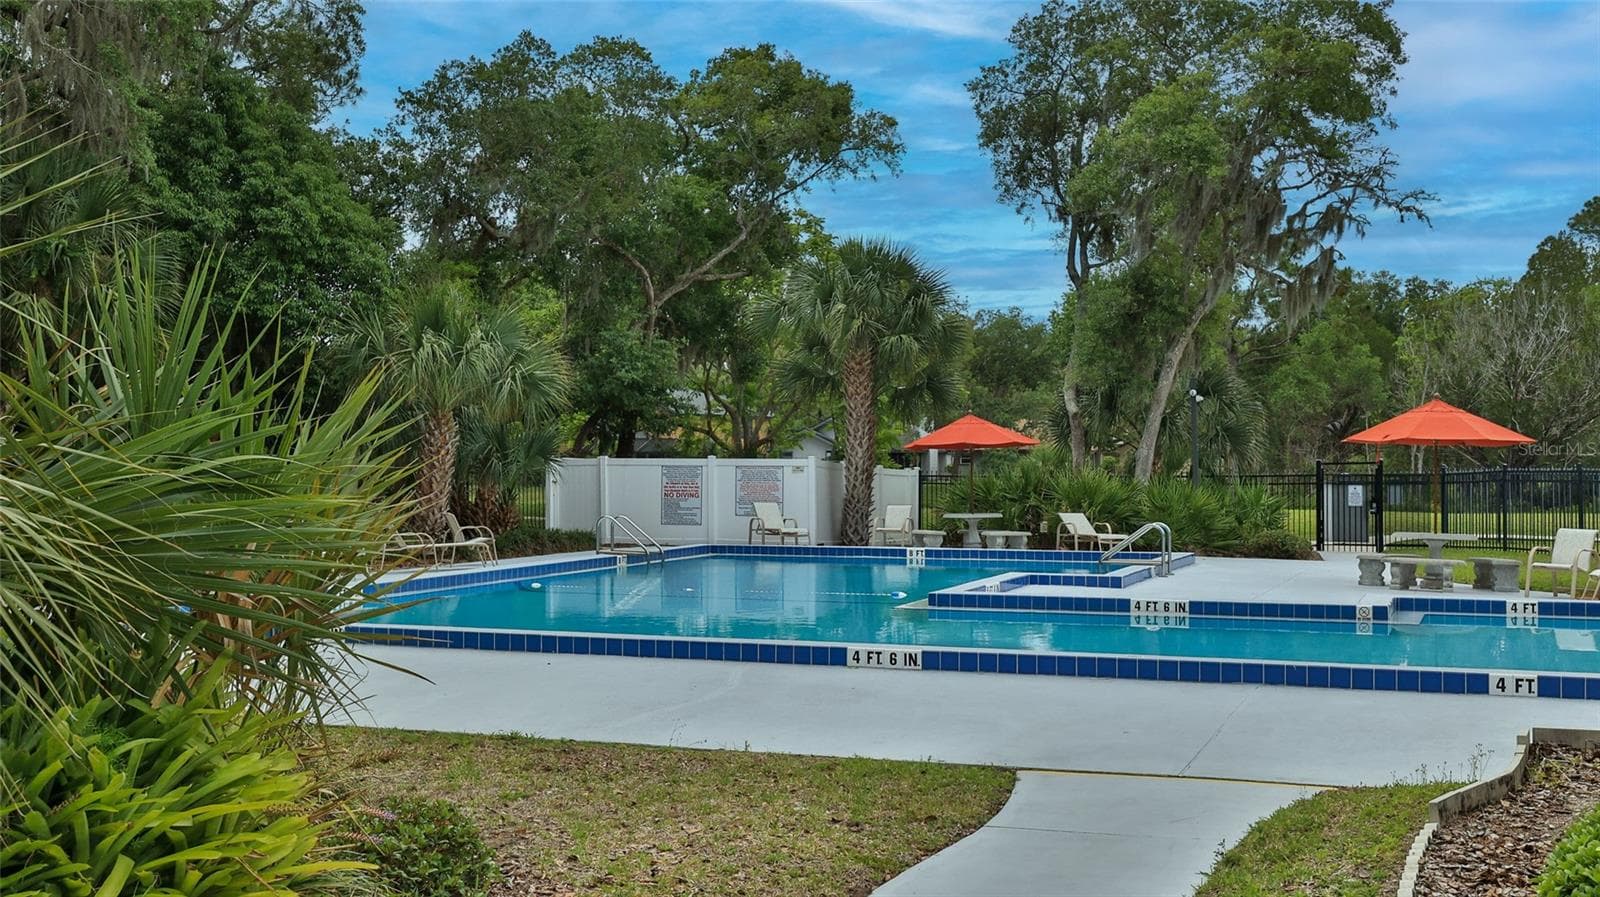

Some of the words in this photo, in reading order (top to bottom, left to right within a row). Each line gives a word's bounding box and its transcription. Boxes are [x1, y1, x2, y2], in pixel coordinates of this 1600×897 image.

[1134, 600, 1141, 611] 4
[1163, 602, 1170, 612] 6
[1175, 602, 1188, 613] IN.
[1511, 603, 1518, 613] 4
[1523, 603, 1537, 614] FT.
[852, 650, 860, 664] 4
[867, 651, 883, 665] FT.
[889, 652, 897, 666] 6
[904, 652, 920, 667] IN.
[1496, 677, 1506, 692] 4
[1515, 678, 1535, 694] FT.
